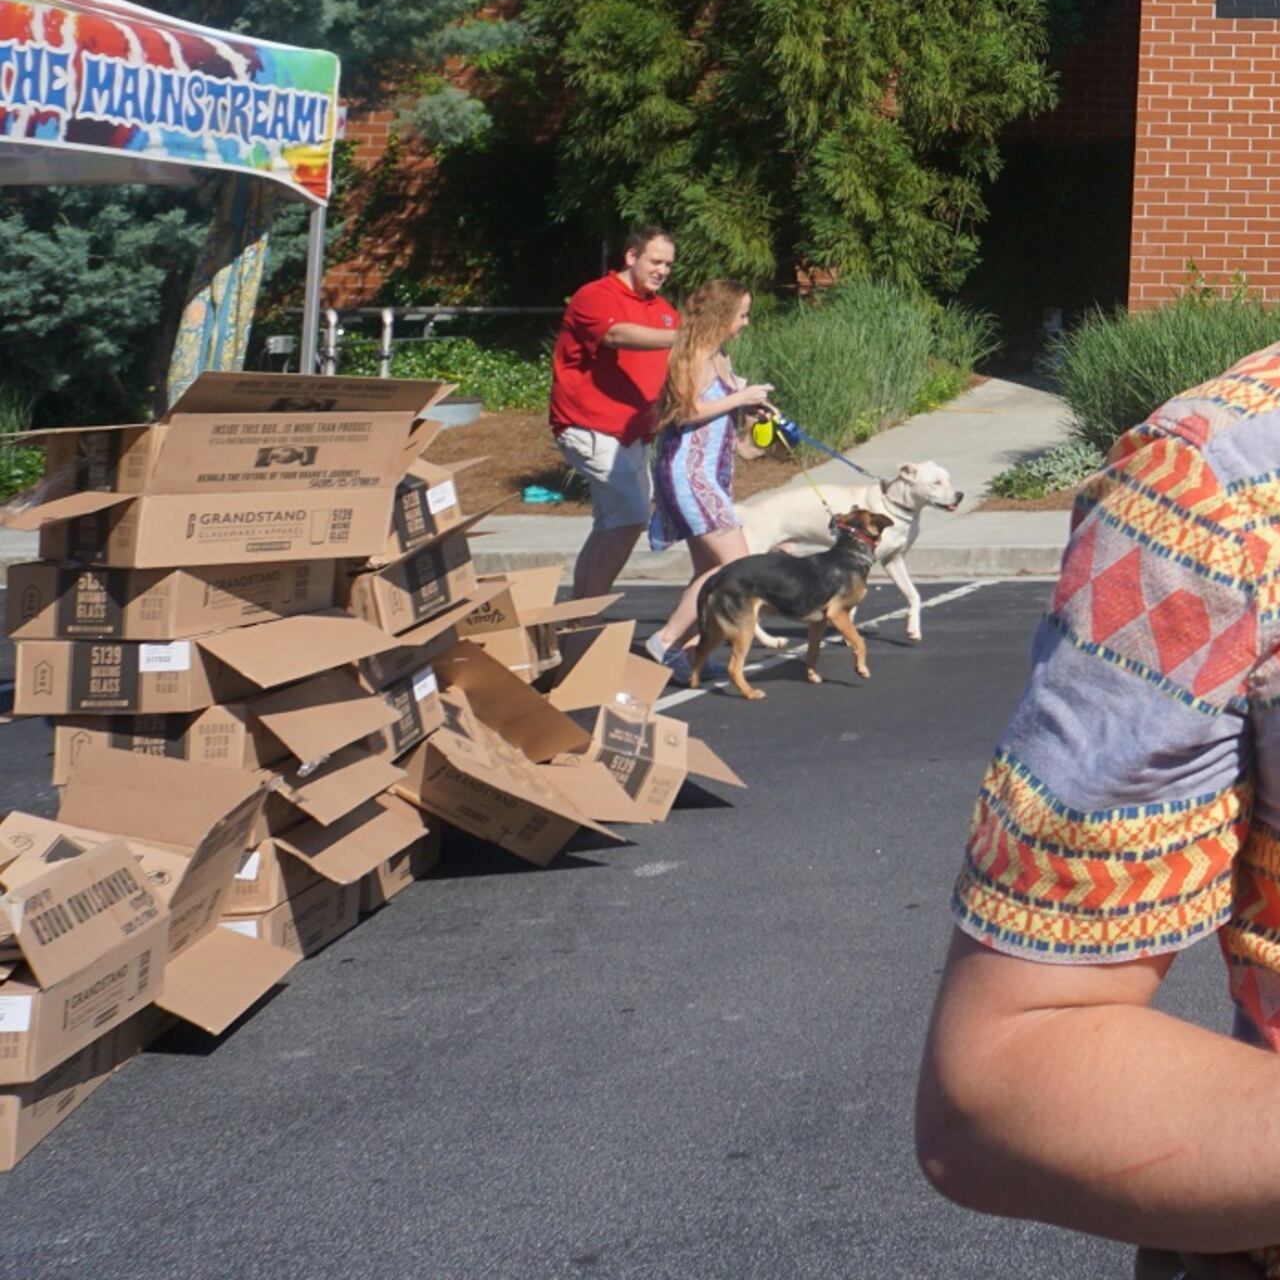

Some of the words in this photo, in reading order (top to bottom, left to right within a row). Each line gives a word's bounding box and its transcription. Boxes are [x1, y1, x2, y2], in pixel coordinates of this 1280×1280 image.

[200, 510, 307, 526] GRANDSTAND
[76, 604, 107, 619] GLASS
[91, 646, 122, 665] 5139
[90, 678, 121, 693] GLASS
